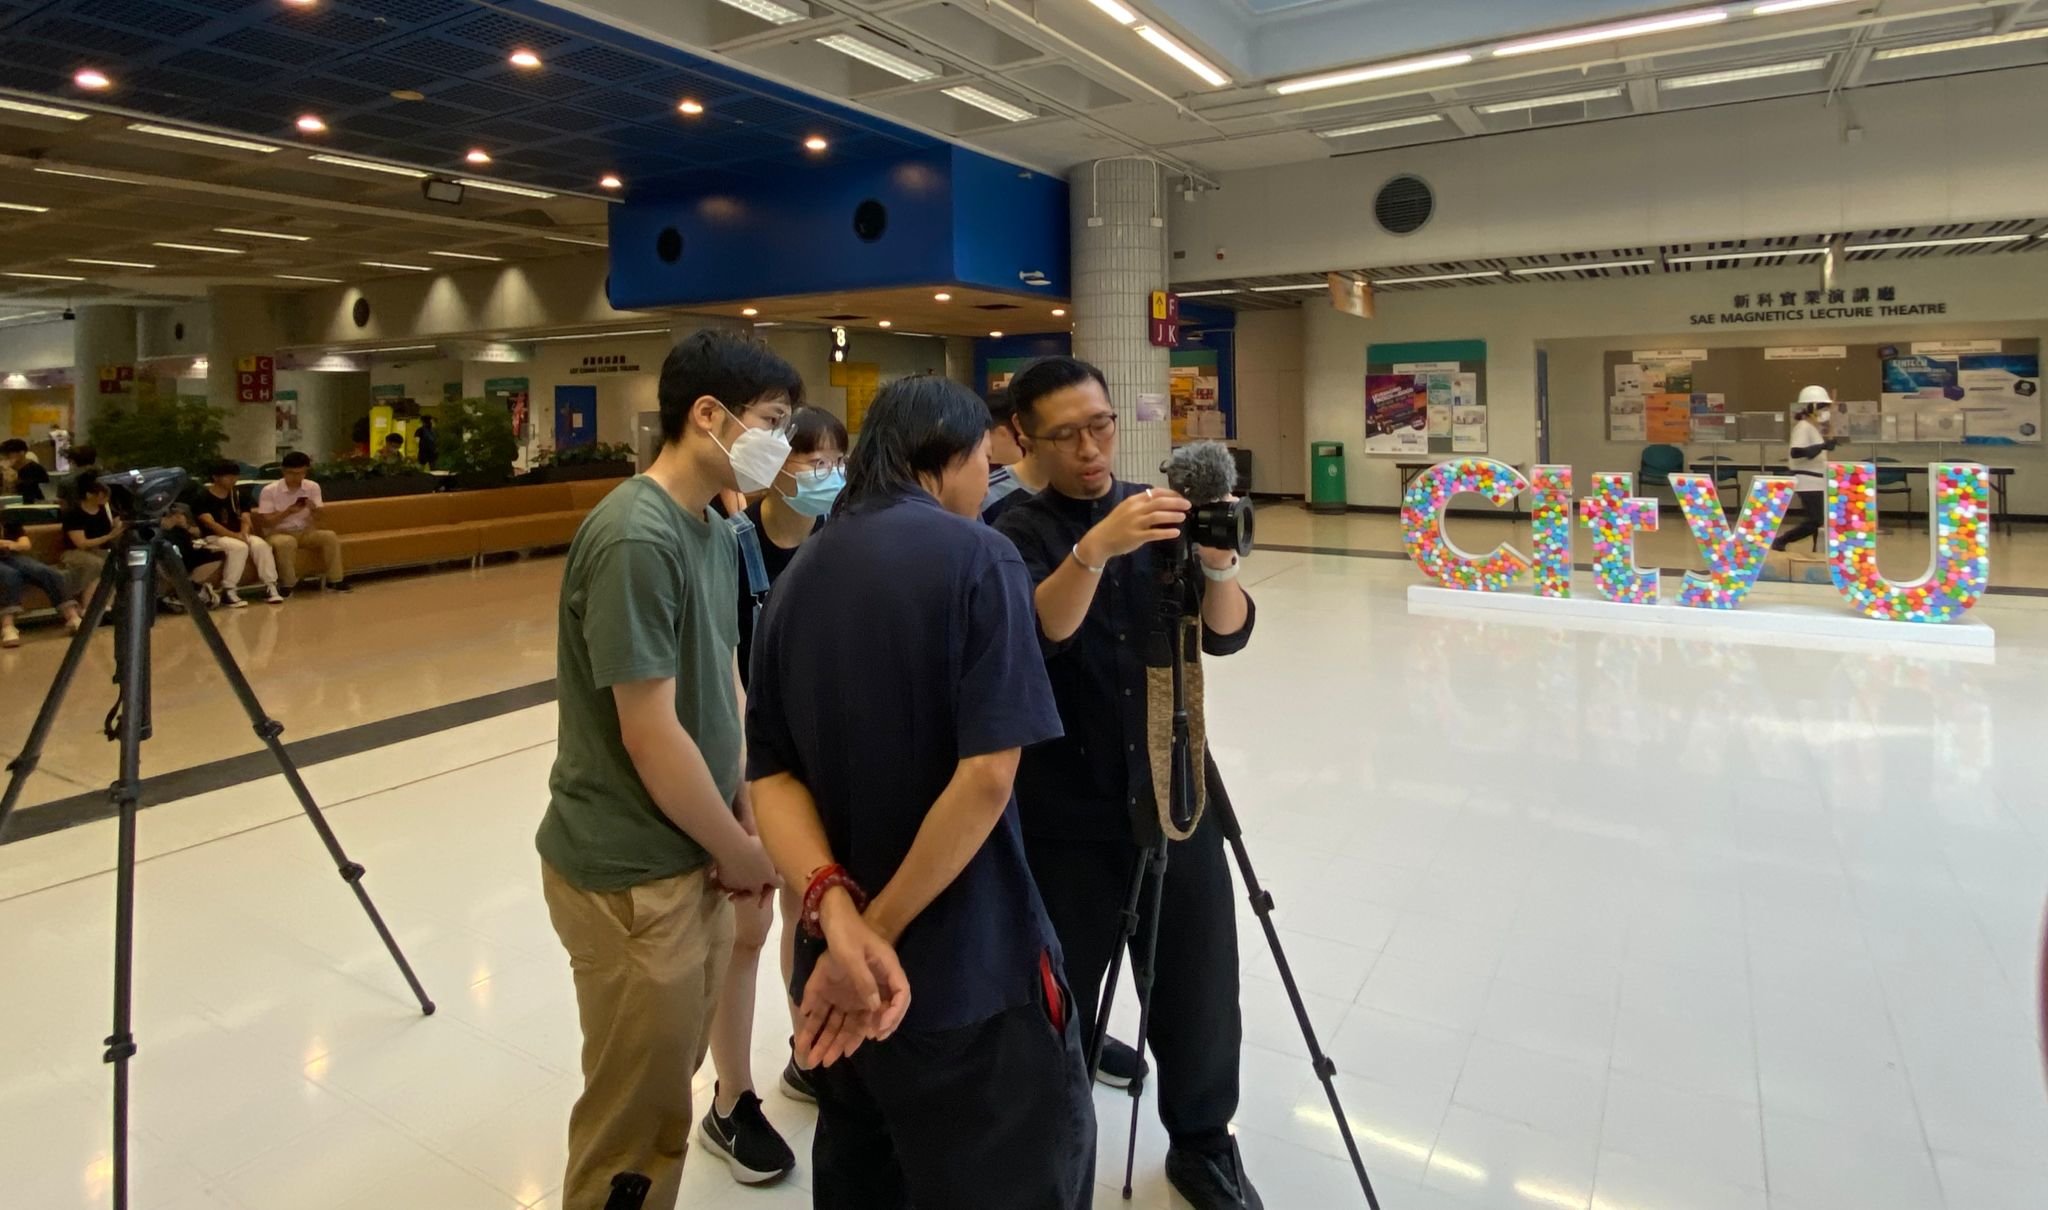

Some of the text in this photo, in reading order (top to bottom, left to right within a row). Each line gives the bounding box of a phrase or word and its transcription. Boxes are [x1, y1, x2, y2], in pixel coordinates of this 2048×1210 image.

[1169, 299, 1175, 315] F
[1689, 302, 1947, 325] SAE MAGNETICS LECTURE THEATRE
[1157, 324, 1176, 343] J K
[260, 359, 268, 369] C
[242, 374, 268, 384] D E
[242, 389, 269, 400] G H
[1400, 456, 1990, 624] CityU
